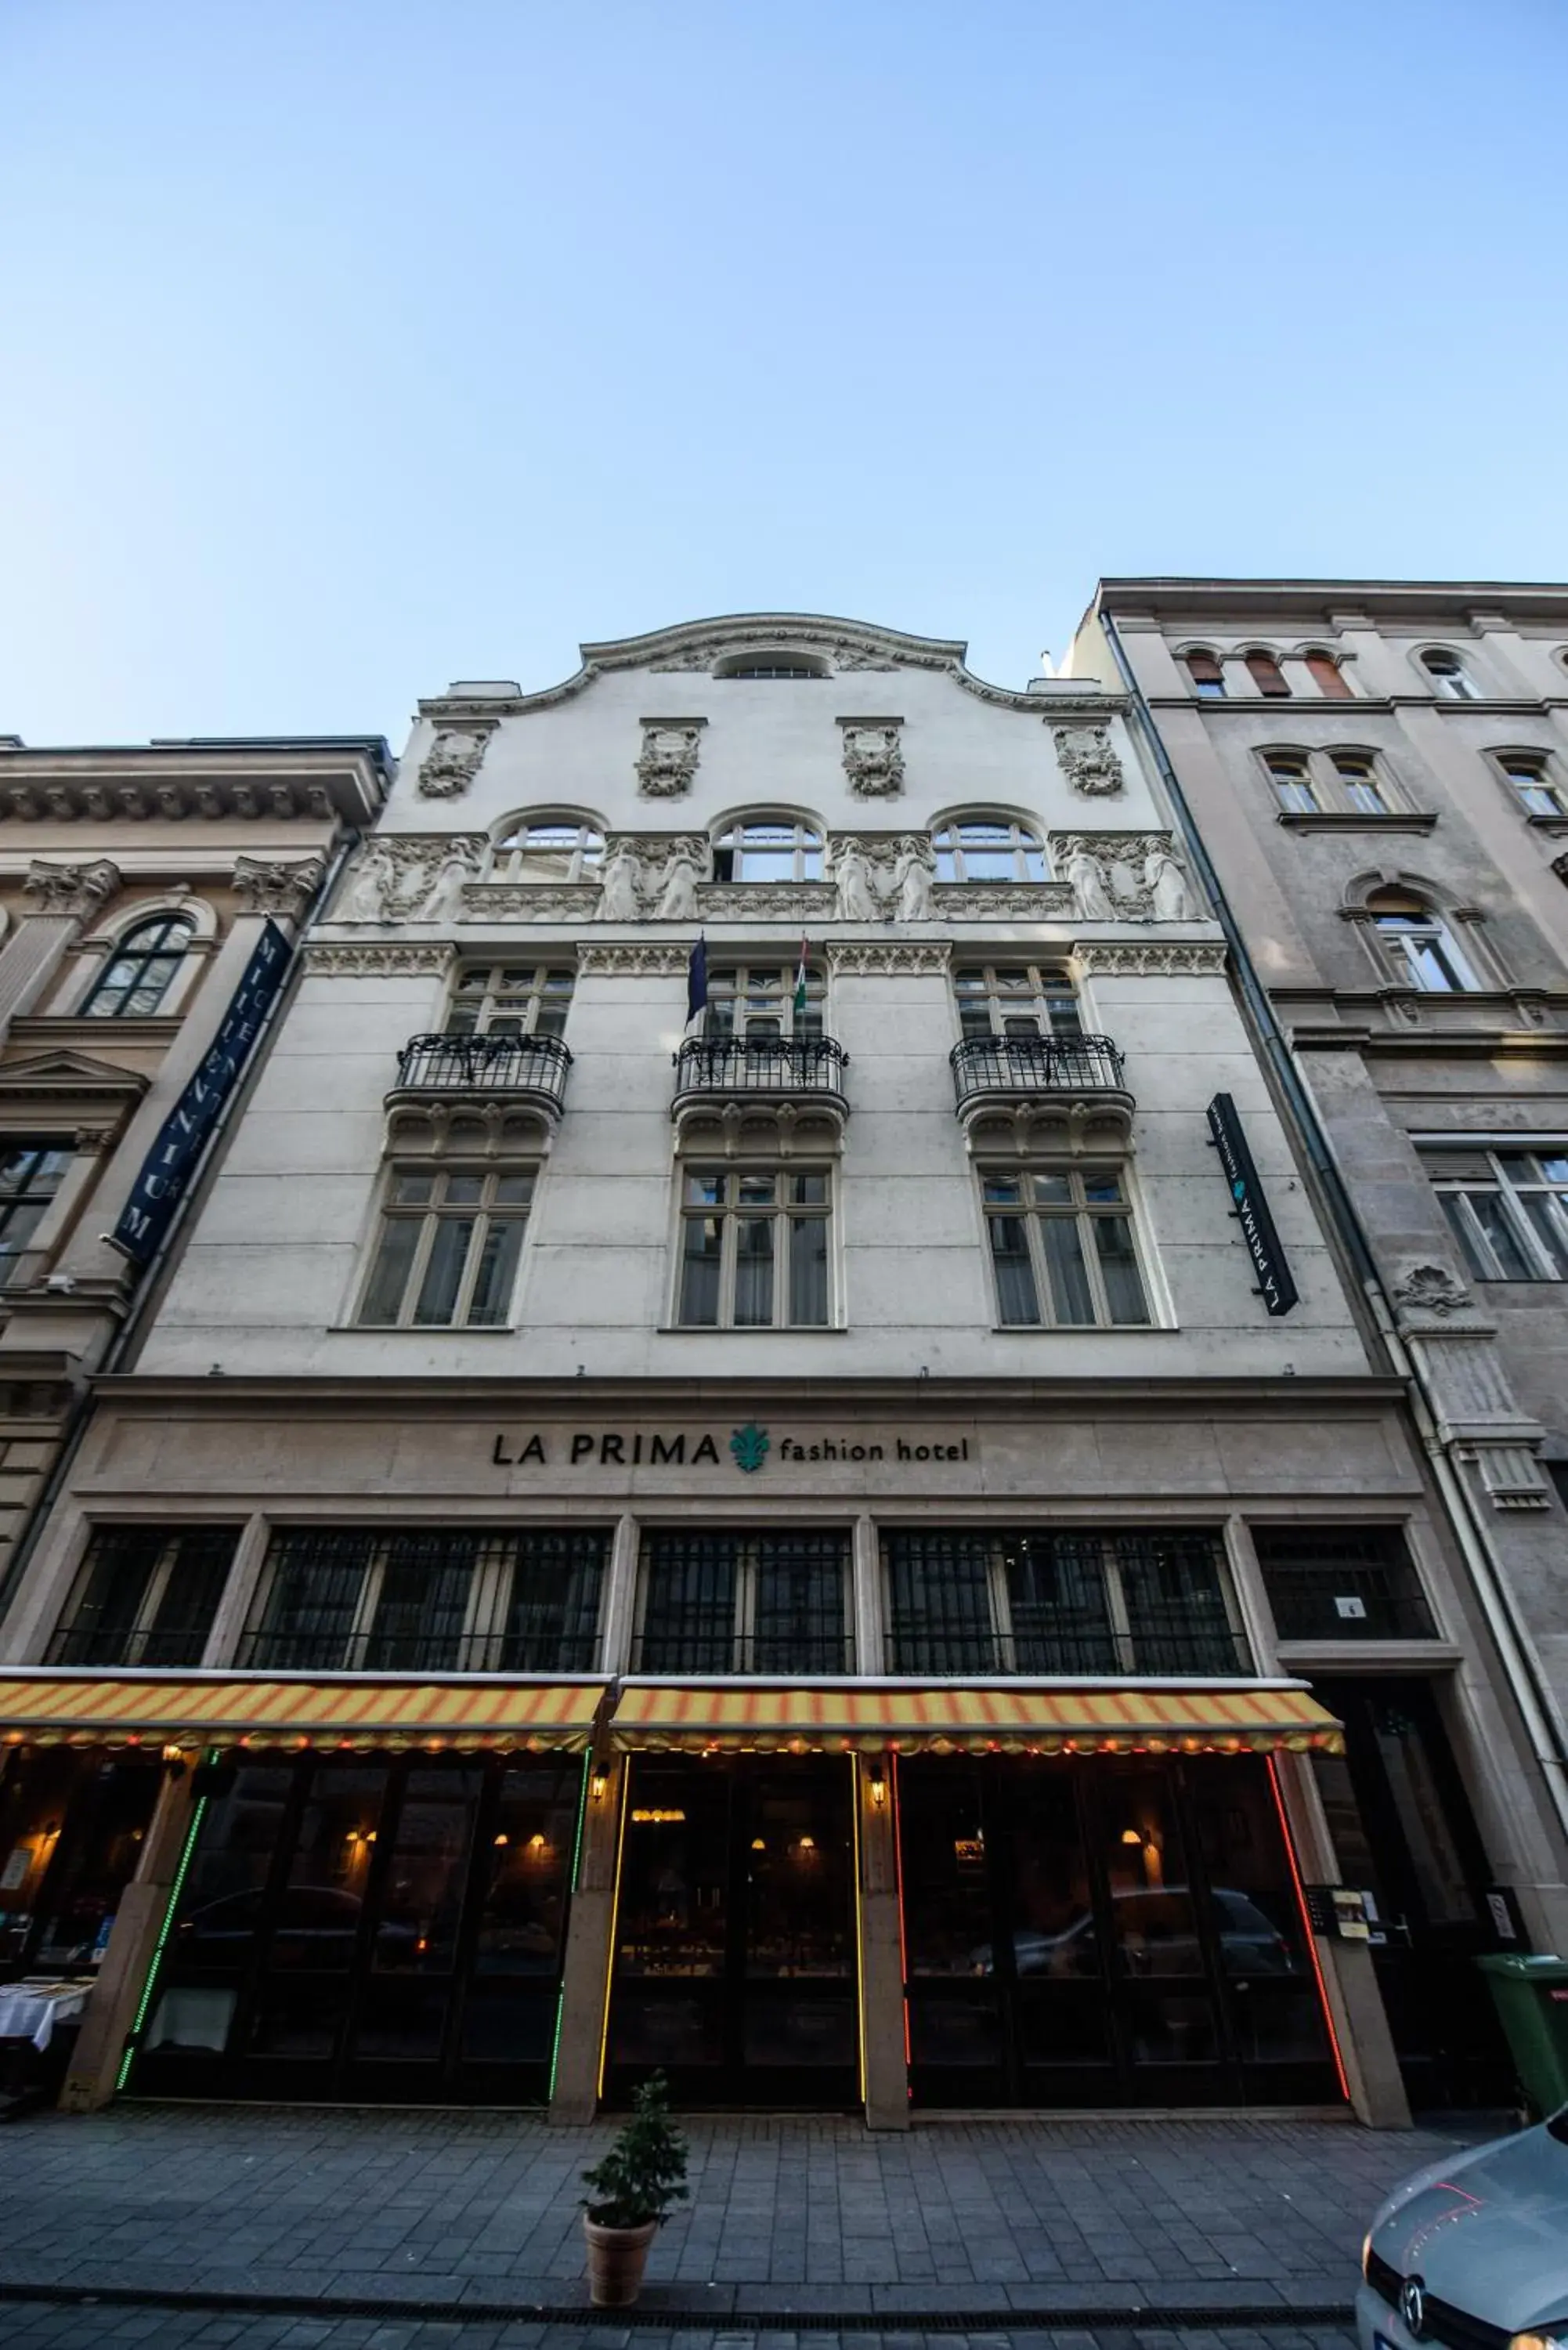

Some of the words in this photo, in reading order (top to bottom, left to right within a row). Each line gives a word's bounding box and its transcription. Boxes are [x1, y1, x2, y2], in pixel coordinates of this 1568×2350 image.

[123, 937, 276, 1241] MILLENNIUM
[1241, 1198, 1267, 1271] PRIMA
[1266, 1276, 1279, 1307] LA
[492, 1435, 546, 1464] LA
[570, 1435, 720, 1465] PRIMA
[779, 1438, 883, 1461] fashion
[897, 1439, 968, 1461] hotel
